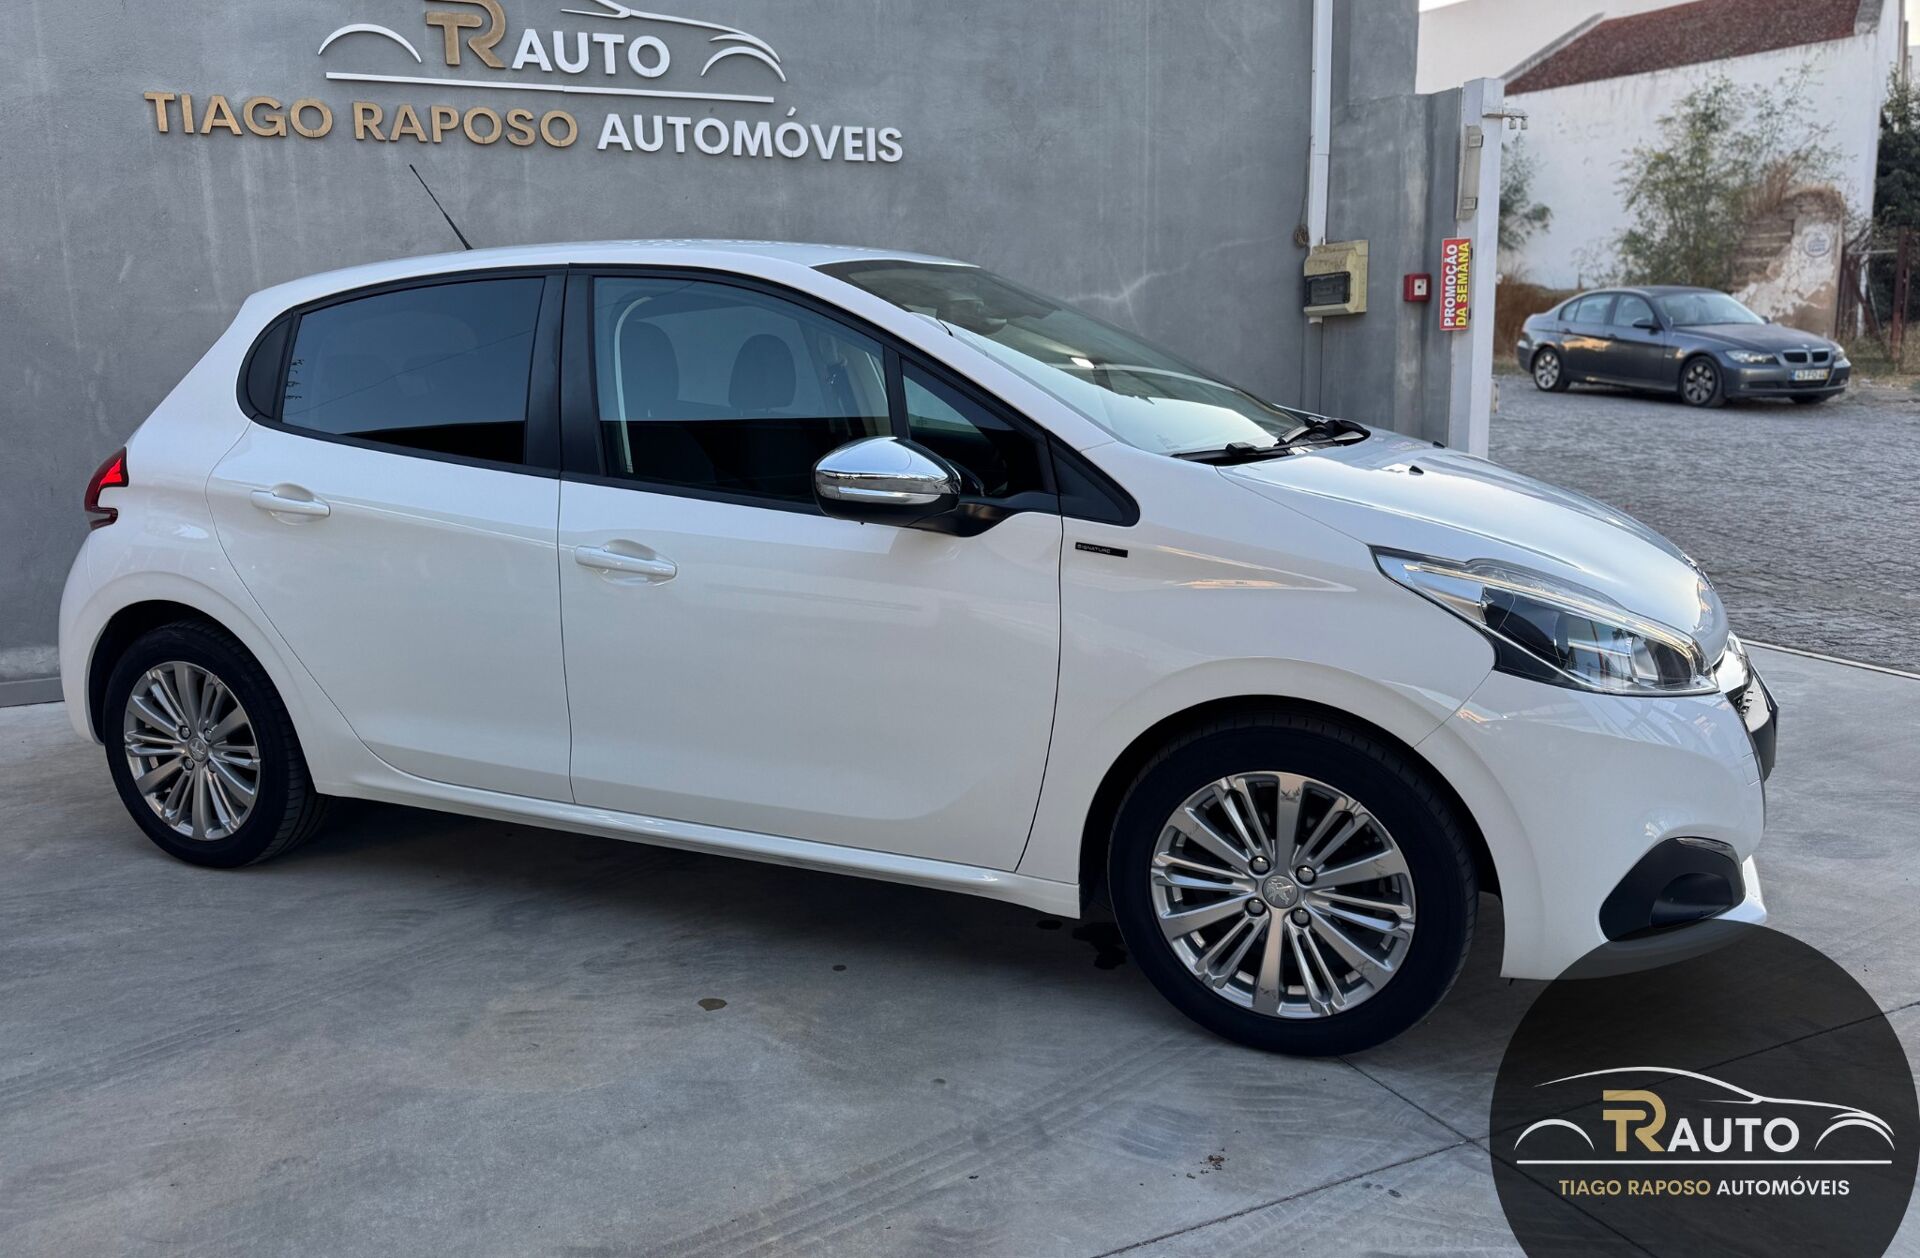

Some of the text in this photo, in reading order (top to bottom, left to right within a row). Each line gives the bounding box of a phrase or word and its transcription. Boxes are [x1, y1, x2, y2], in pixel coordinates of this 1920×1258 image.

[511, 28, 671, 78] AUTO
[144, 91, 903, 162] TIAGO RAPOSO AUTOMÓVEIS
[1443, 244, 1458, 327] PROMOÇÃO
[1456, 242, 1469, 326] DA SEMANA
